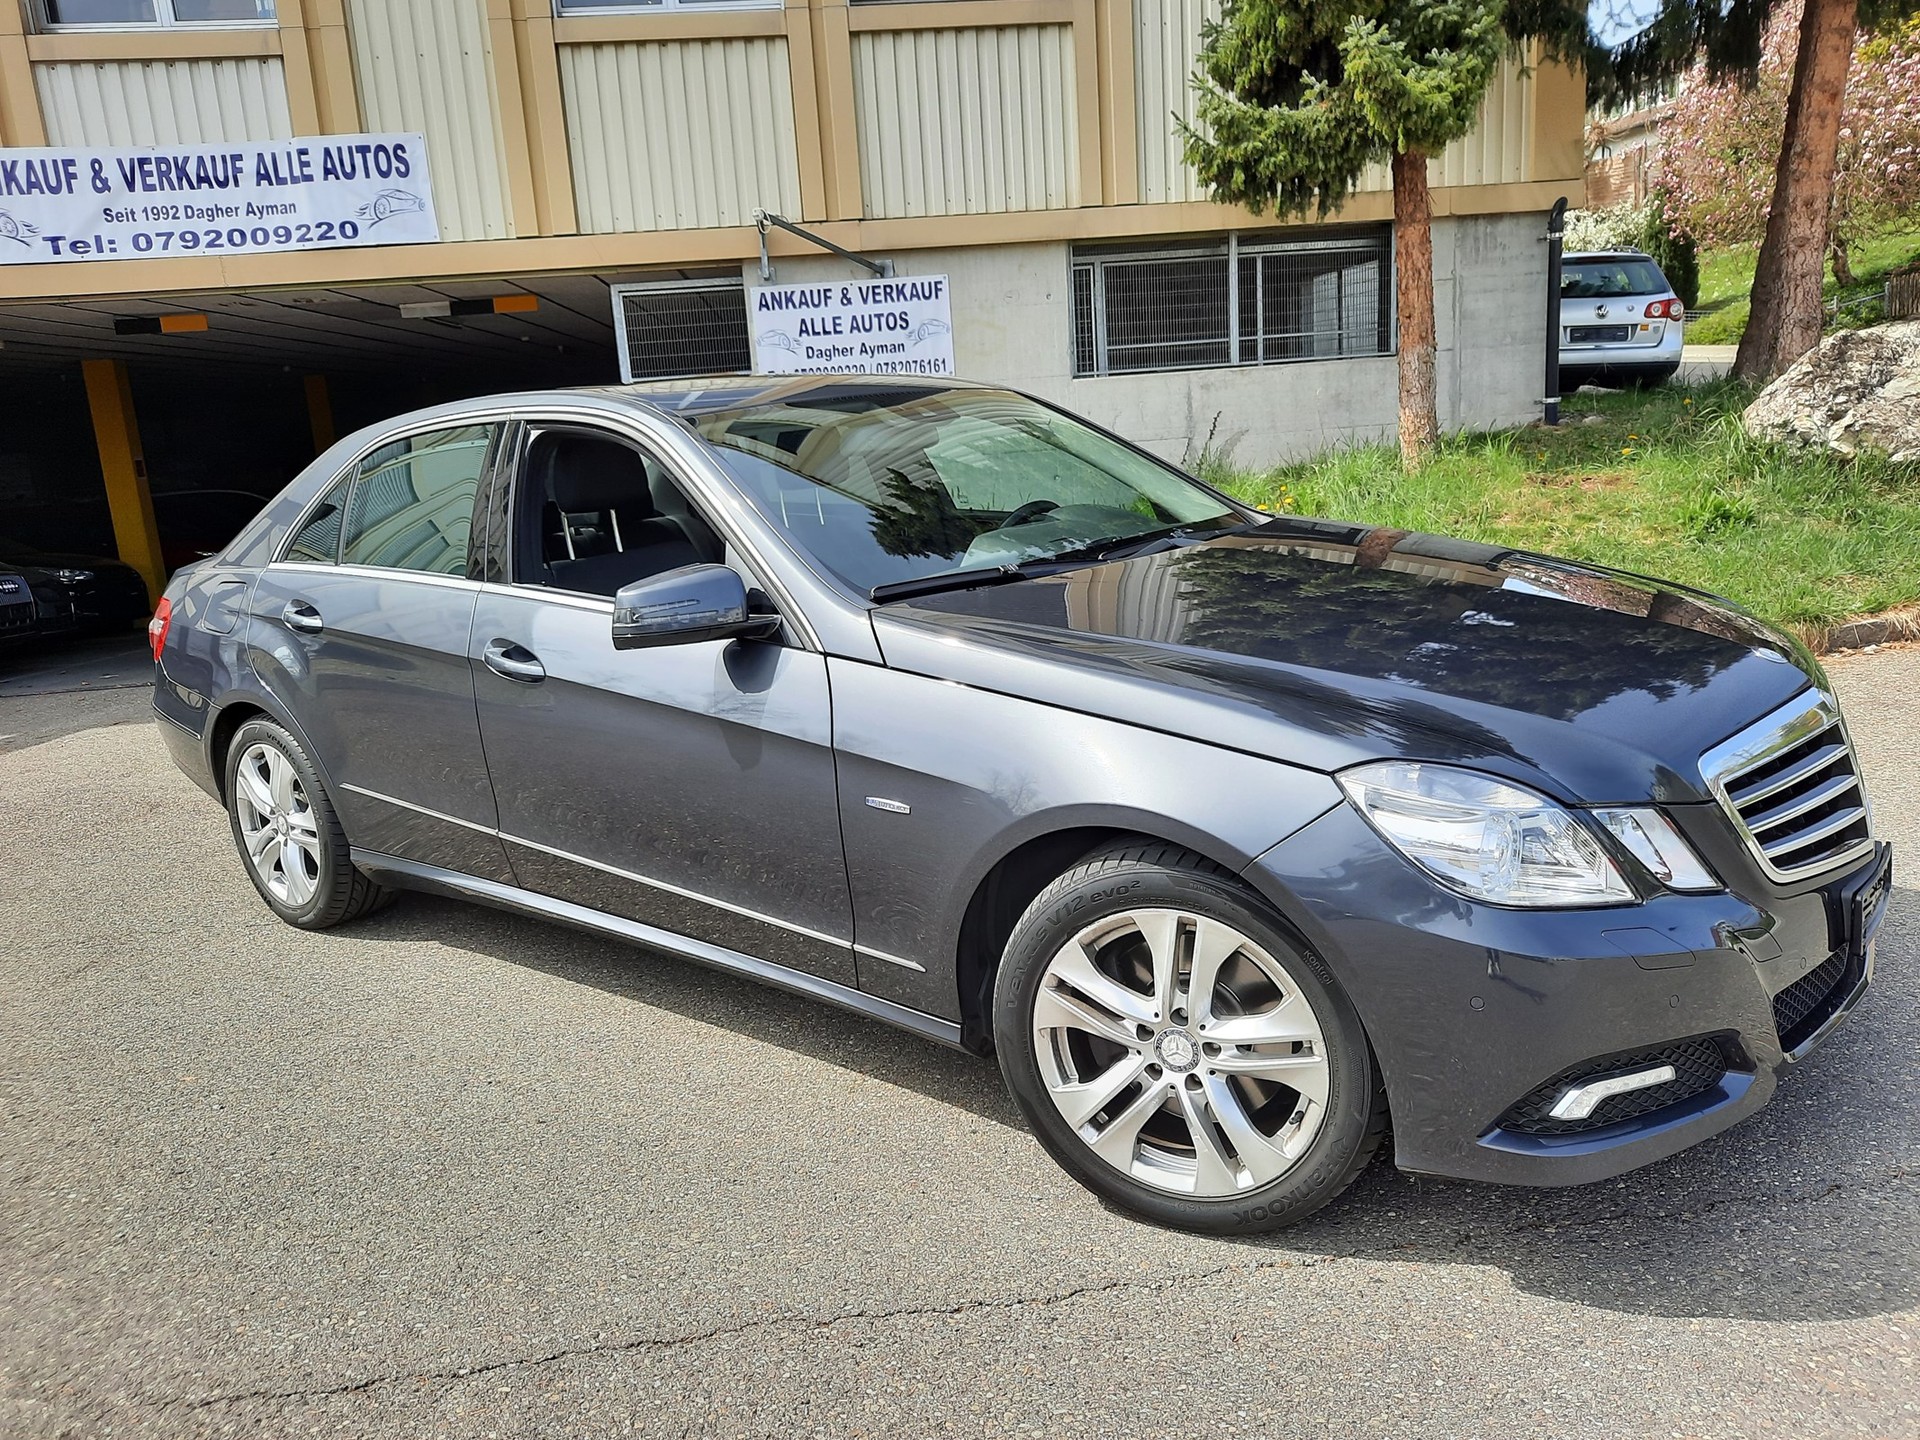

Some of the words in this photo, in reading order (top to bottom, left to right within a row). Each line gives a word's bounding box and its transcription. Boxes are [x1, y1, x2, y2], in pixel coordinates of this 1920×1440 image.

[0, 158, 78, 196] KAUF
[90, 157, 111, 194] &
[116, 153, 244, 193] VERKAUF
[255, 147, 315, 187] ALLE
[322, 143, 410, 181] AUTOS
[103, 206, 138, 223] Seit
[142, 204, 180, 222] 1992
[184, 202, 240, 222] Dagher
[245, 201, 297, 217] Ayman
[42, 234, 118, 256] Tel:
[131, 220, 359, 253] 0792009220
[758, 288, 833, 312] ANKAUF
[840, 286, 853, 307] &
[858, 280, 944, 305] VERKAUF
[799, 315, 844, 338] ALLE
[849, 310, 910, 334] AUTOS
[806, 345, 855, 362] Dagher
[859, 341, 906, 359] Ayman
[1046, 894, 1087, 927] V12
[1303, 950, 1334, 985] Kontrol
